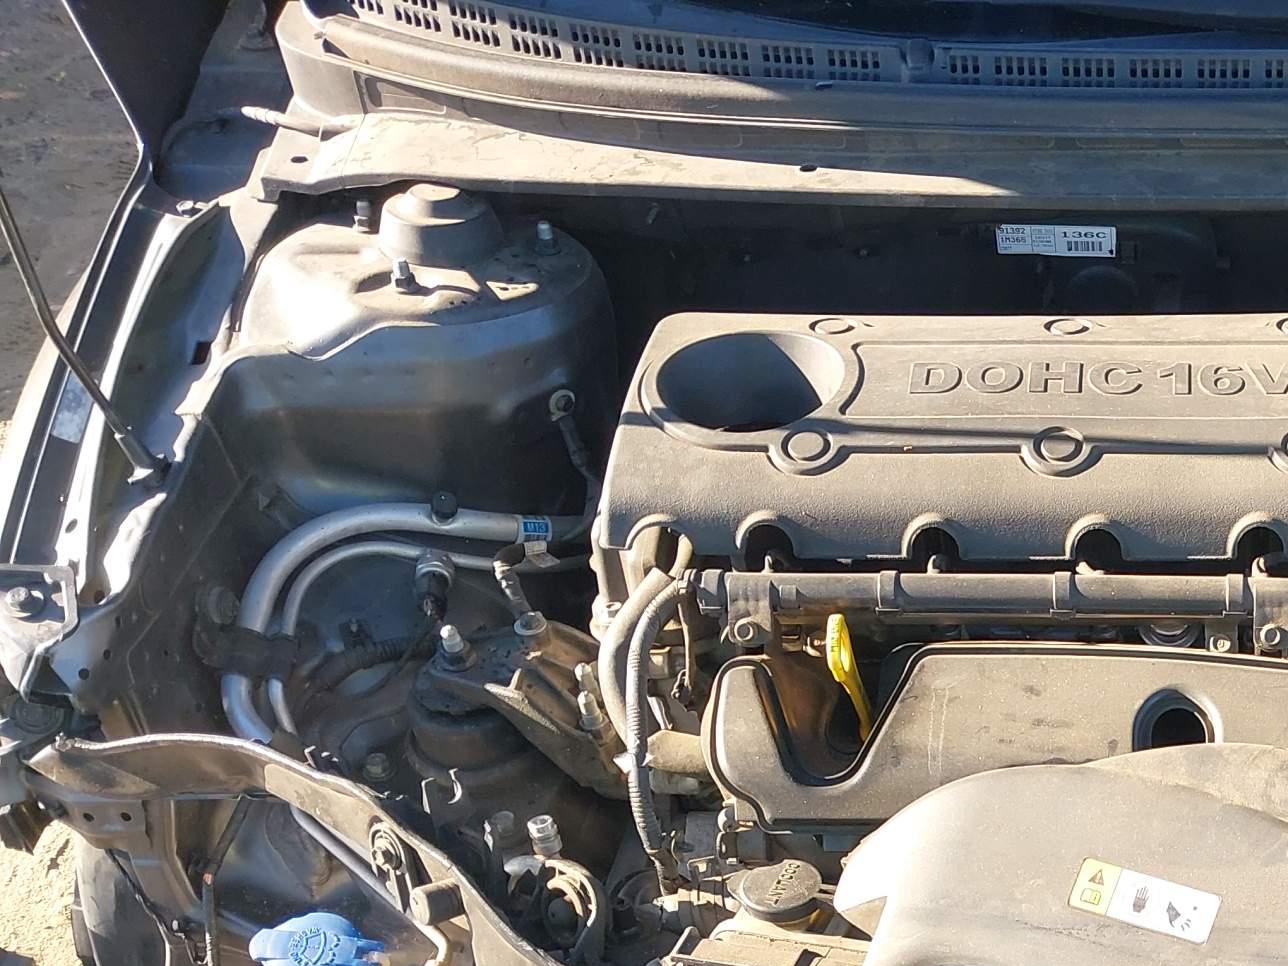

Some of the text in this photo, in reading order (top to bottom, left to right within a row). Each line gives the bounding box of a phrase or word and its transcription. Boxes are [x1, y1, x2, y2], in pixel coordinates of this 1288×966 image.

[1061, 231, 1107, 239] 136C
[907, 360, 1144, 396] DOHC
[763, 862, 801, 906] COOLANT
